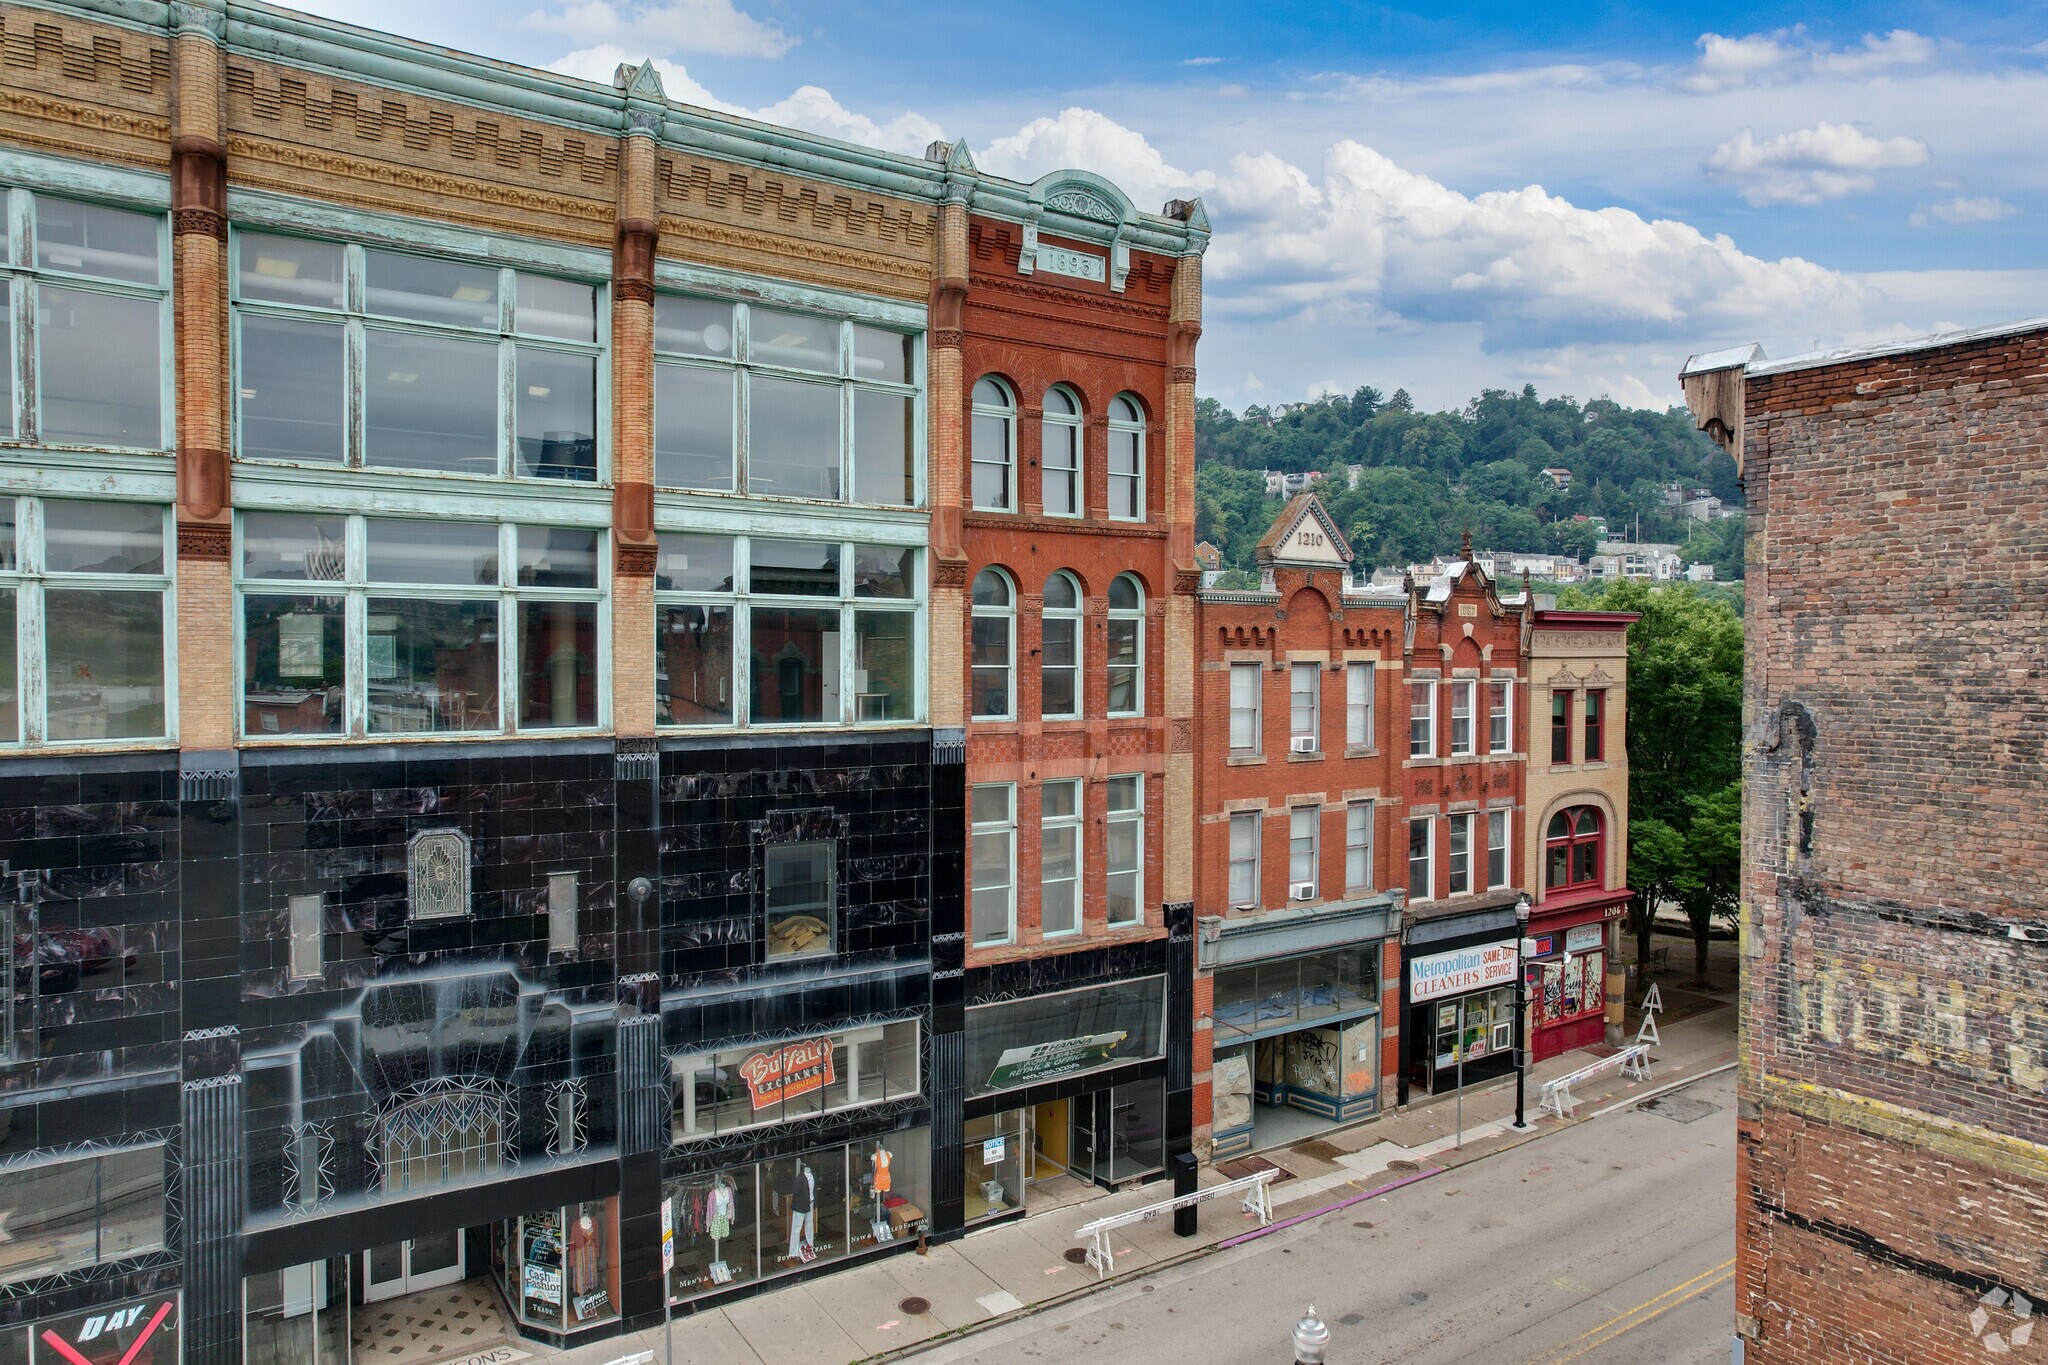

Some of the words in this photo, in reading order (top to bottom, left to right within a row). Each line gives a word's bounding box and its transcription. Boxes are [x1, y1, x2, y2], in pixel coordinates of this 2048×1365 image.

[1049, 252, 1092, 276] 1893
[1297, 532, 1323, 547] 1210
[1459, 604, 1476, 615] 1887
[1604, 906, 1621, 918] 1206
[1482, 949, 1501, 964] SAME
[1502, 946, 1515, 960] DAY
[1414, 953, 1481, 979] Metropolitan
[1484, 962, 1512, 980] SERVICE
[1413, 970, 1480, 997] CLEANERS
[1047, 1038, 1093, 1051] HANNA
[1470, 1042, 1485, 1053] ATM
[1009, 1064, 1042, 1078] RETAIL
[1054, 1051, 1089, 1066] OFFICE
[758, 1062, 828, 1094] EXCHANGE
[984, 1138, 1005, 1149] NOTICE
[1172, 1200, 1189, 1211] ROAD
[1192, 1192, 1215, 1205] CLOSED
[525, 1278, 561, 1292] Fashion
[528, 1269, 551, 1283] Cash
[550, 1274, 560, 1283] for
[77, 1304, 146, 1343] DAY
